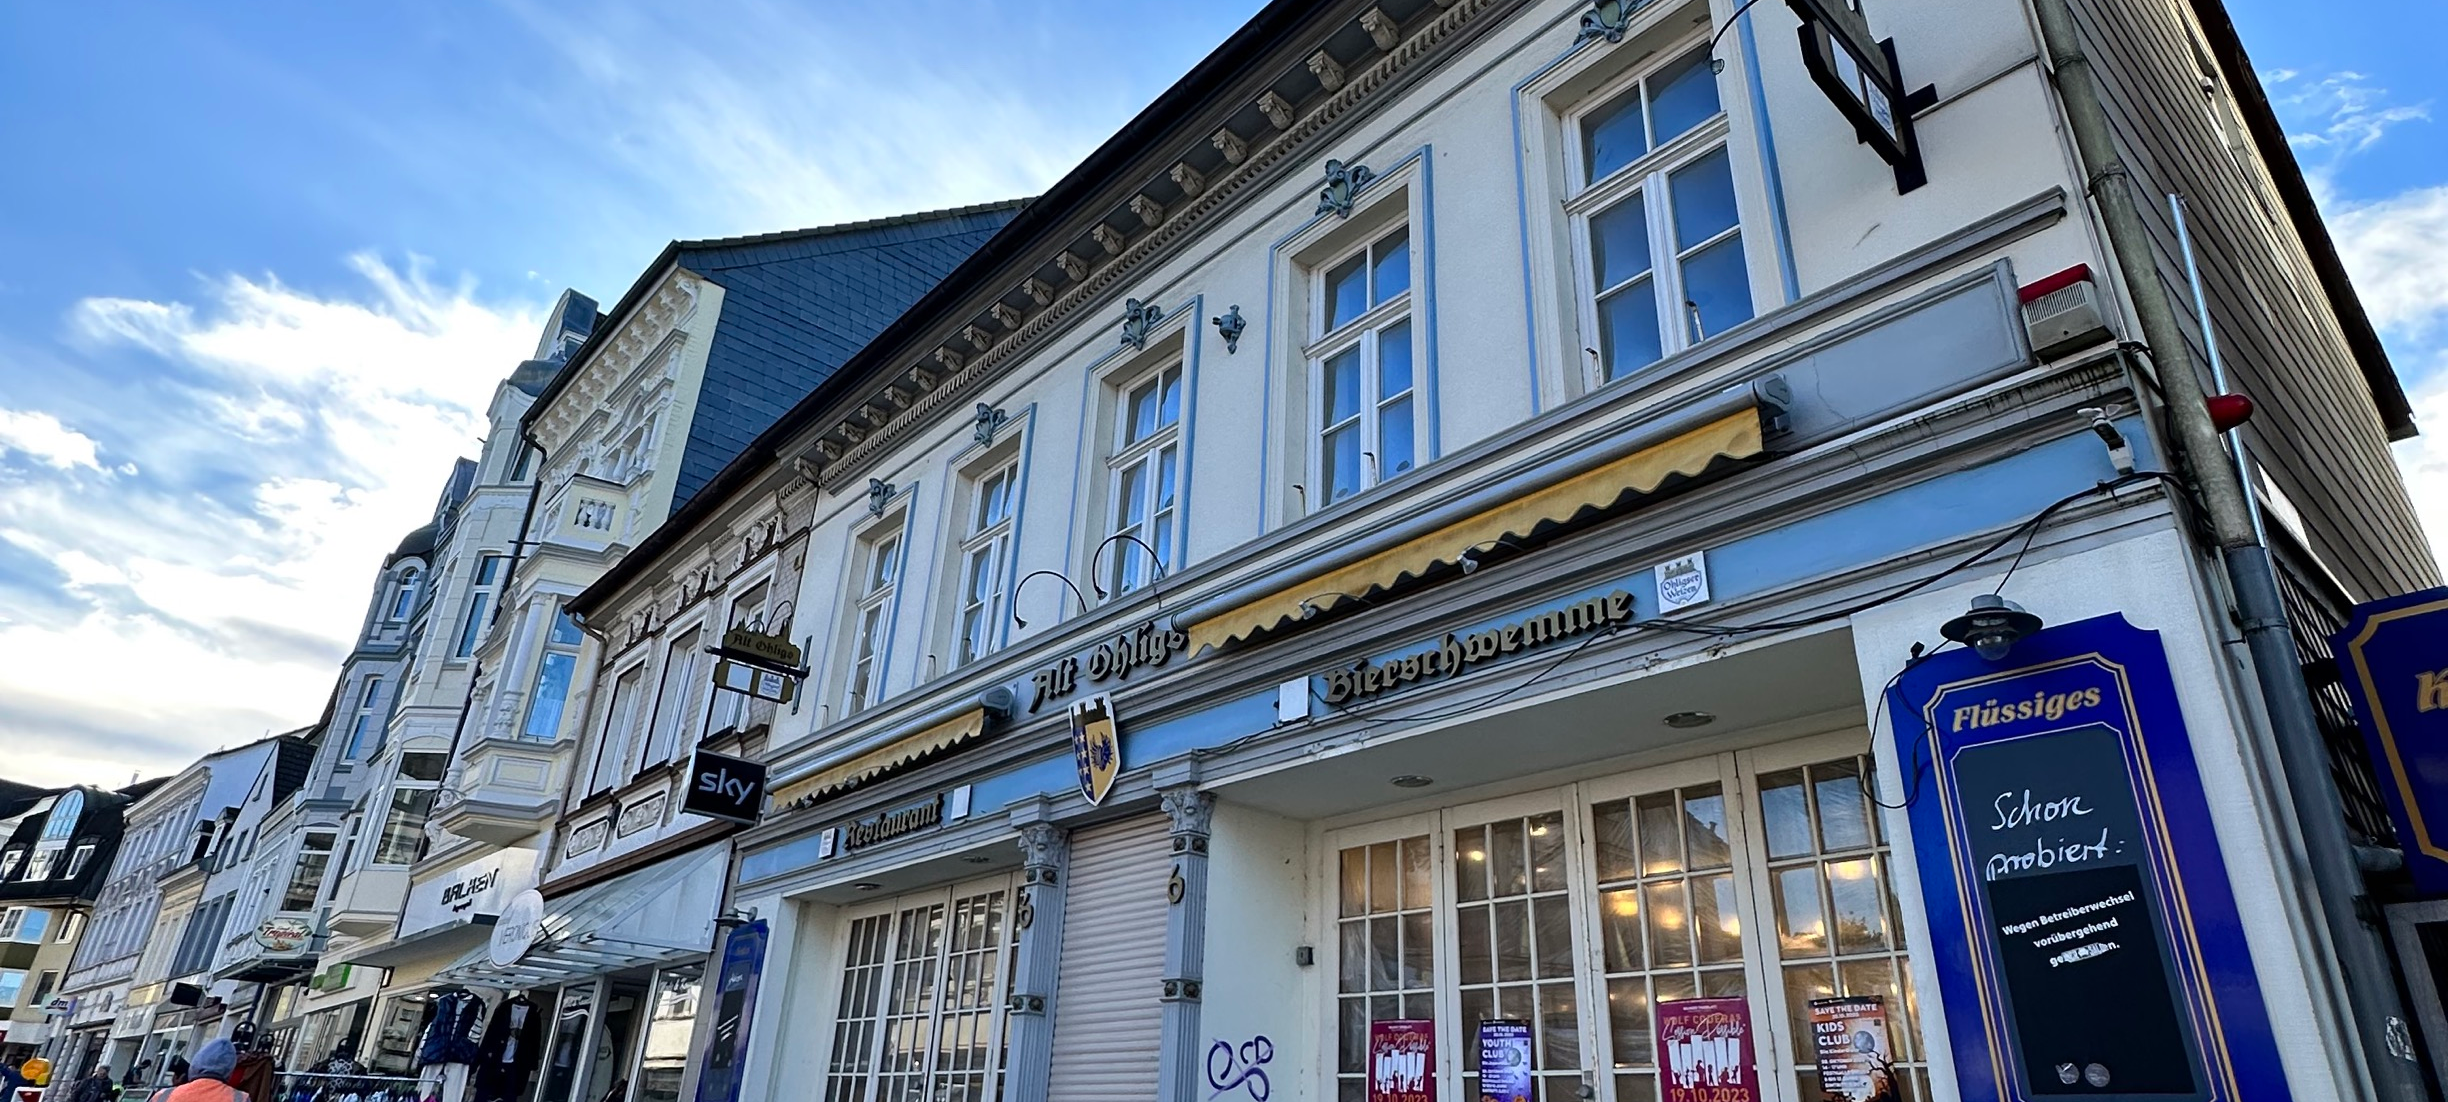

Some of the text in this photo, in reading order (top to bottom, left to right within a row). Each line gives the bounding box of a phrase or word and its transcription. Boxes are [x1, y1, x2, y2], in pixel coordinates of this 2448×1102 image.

[732, 633, 794, 660] Alt Ohligs
[1324, 588, 1635, 704] Bierschwemme
[1029, 621, 1189, 714] Alt Ohligs
[1952, 686, 2102, 733] Flüssiges
[698, 767, 756, 806] sky
[844, 792, 944, 851] Restaurant
[1991, 789, 2094, 830] Schon
[1986, 827, 2126, 881] probiert:
[1166, 863, 1186, 905] 6
[2002, 890, 2135, 936] Wegen Betreiberwechsel
[2033, 916, 2119, 948] vorübergehend
[50, 998, 68, 1007] dm
[1814, 1007, 1835, 1016] SAVE
[1836, 1005, 1852, 1013] THE
[1854, 1003, 1878, 1011] DATE
[1482, 1038, 1513, 1048] YOUTH
[1816, 1021, 1845, 1033] KIDS
[1818, 1034, 1851, 1046] CLUB
[1482, 1049, 1505, 1059] CLUB
